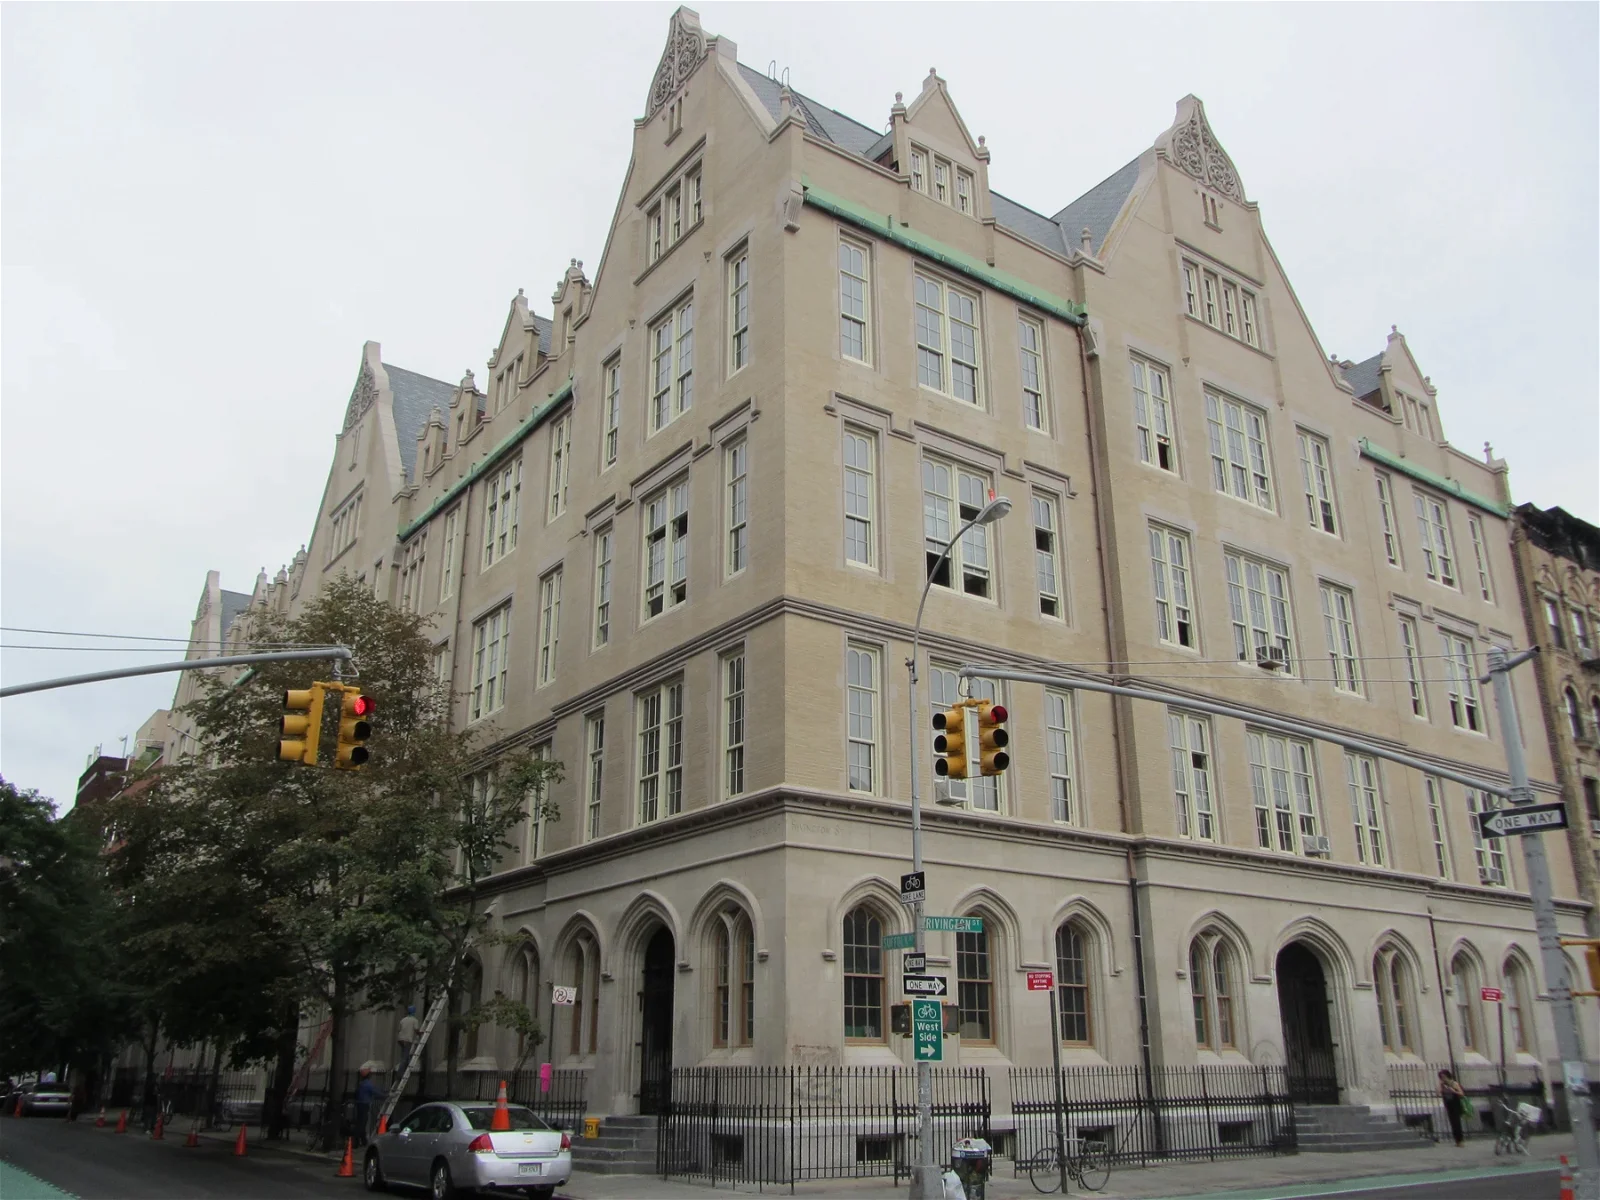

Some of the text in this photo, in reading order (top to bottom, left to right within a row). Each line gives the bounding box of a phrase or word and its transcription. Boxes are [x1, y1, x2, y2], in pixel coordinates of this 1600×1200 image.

[1495, 811, 1554, 829] ONE WAY
[902, 891, 924, 901] BIKE LANE
[926, 918, 971, 931] RIVINGTON
[909, 981, 941, 991] ONE WAY
[917, 1022, 939, 1031] West
[919, 1032, 937, 1042] Side
